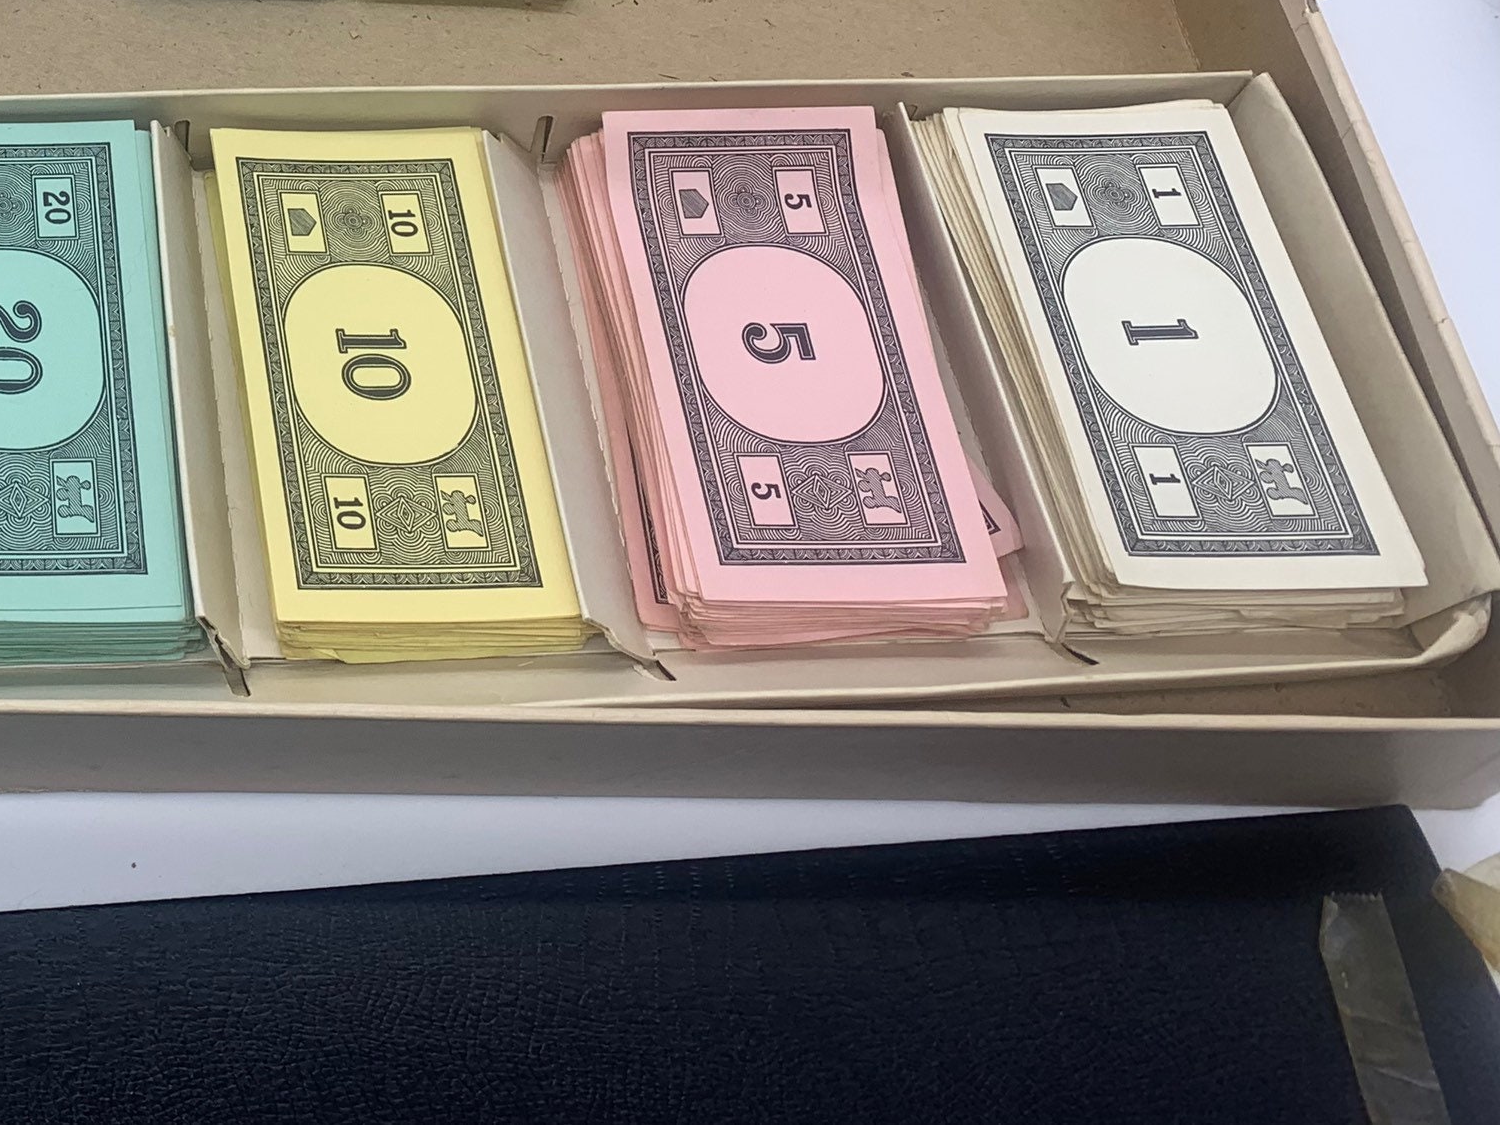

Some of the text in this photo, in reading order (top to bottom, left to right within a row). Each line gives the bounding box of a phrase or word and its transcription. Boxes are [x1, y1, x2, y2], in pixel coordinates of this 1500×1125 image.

[784, 193, 812, 210] 5
[1152, 186, 1183, 199] 1
[42, 191, 71, 225] 20
[387, 209, 419, 237] 10
[742, 322, 817, 364] 5
[1121, 319, 1200, 347] 1
[335, 328, 412, 401] 10
[751, 481, 782, 501] 5
[1149, 473, 1181, 487] 1
[333, 496, 366, 530] 10
